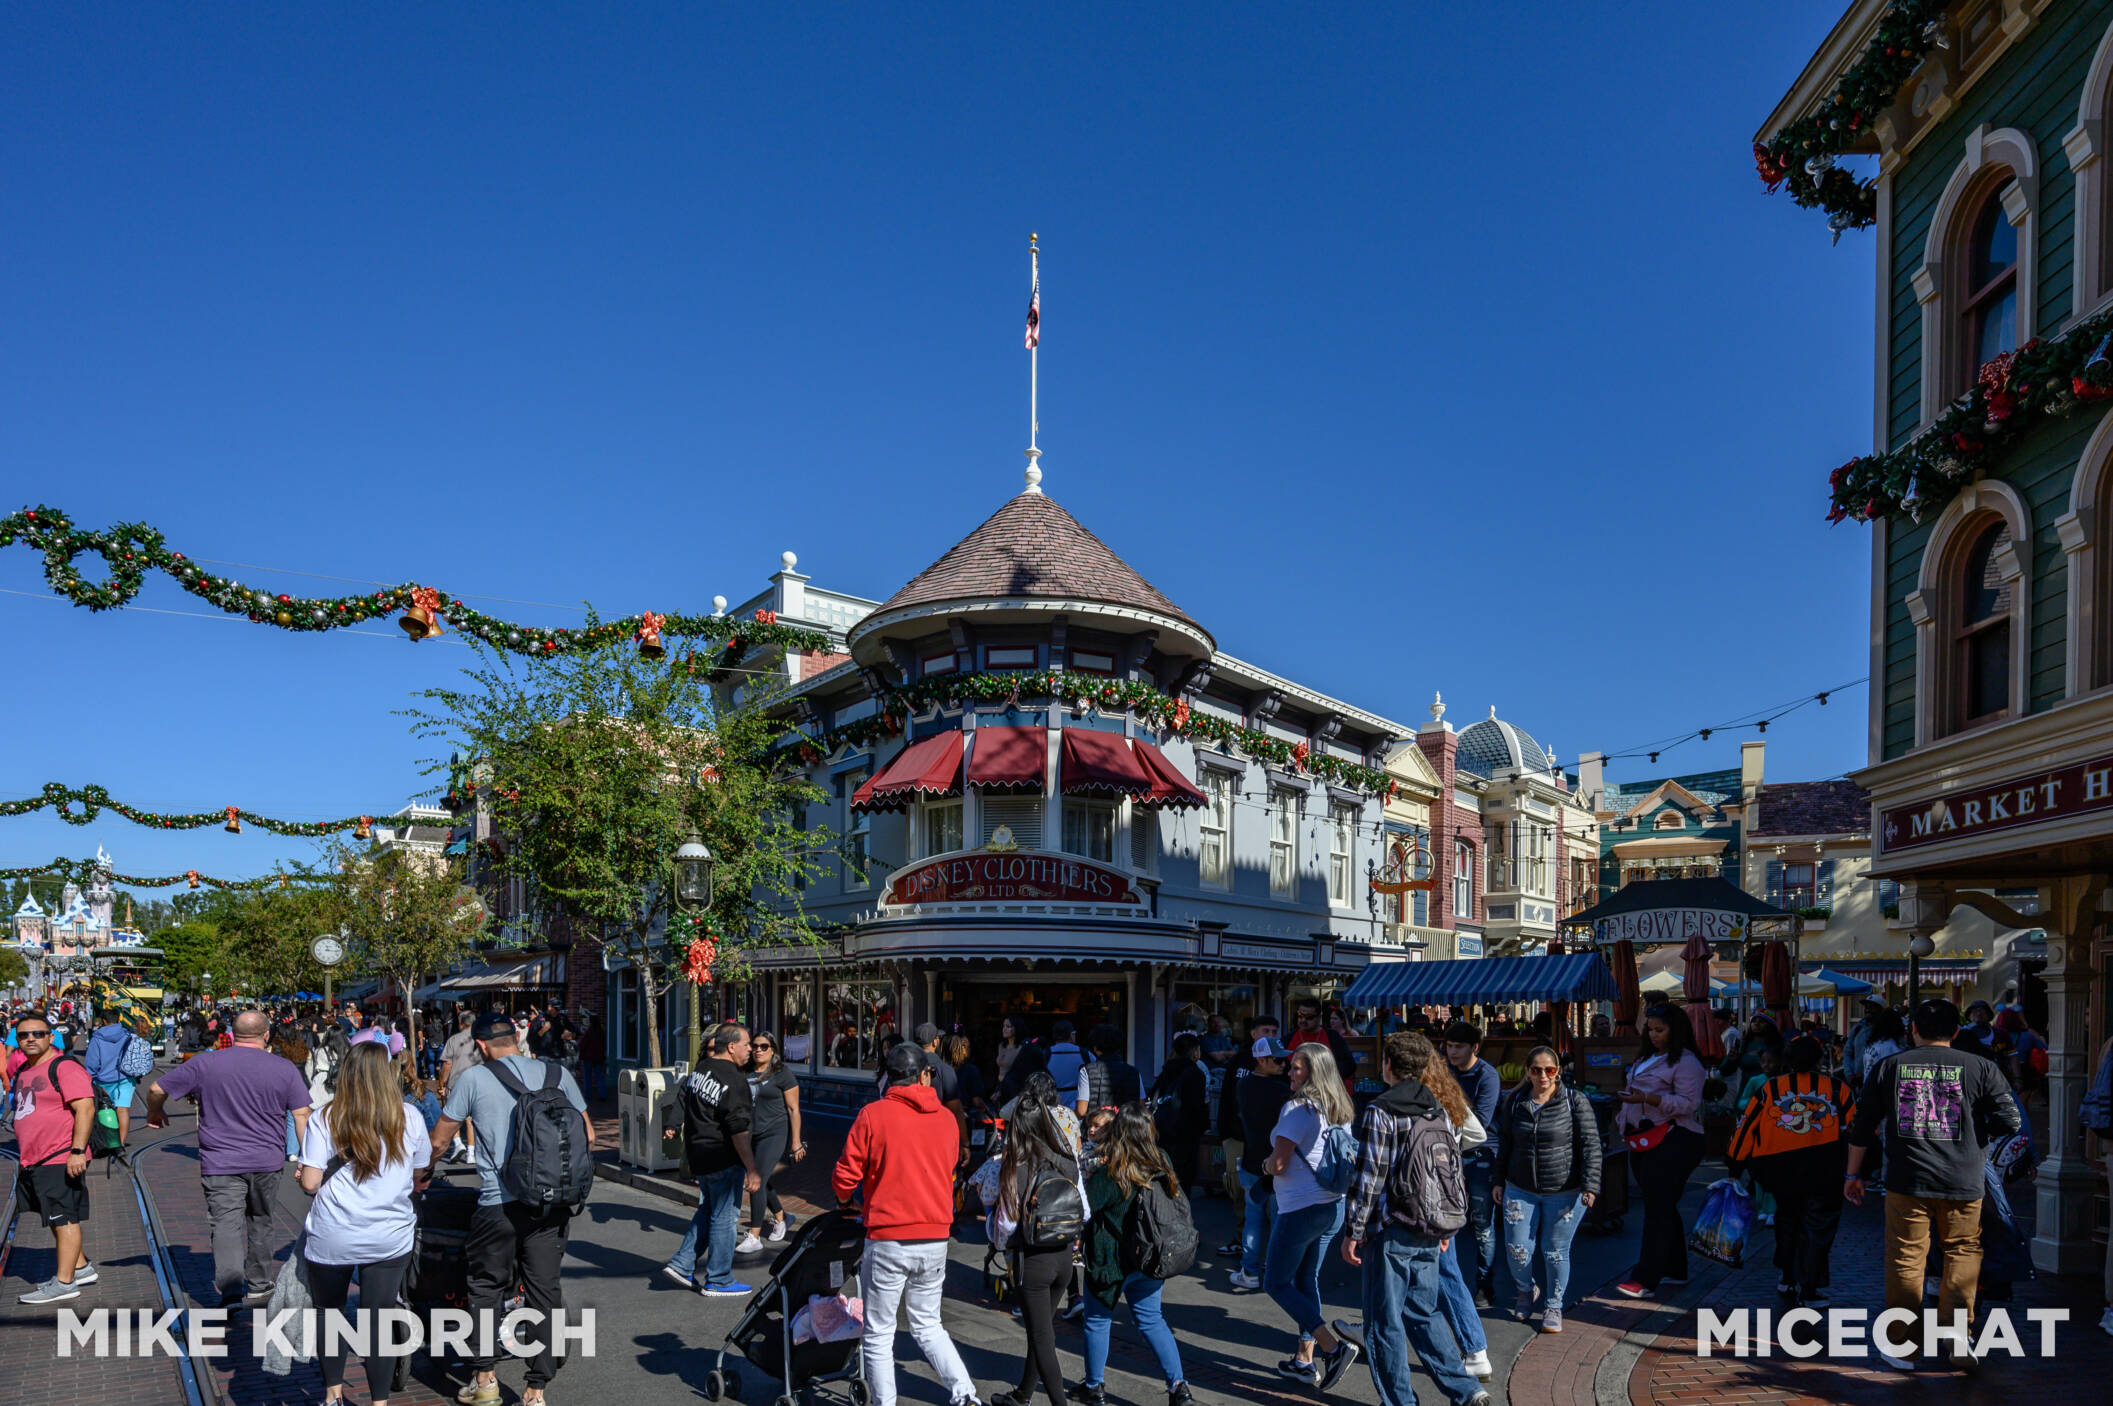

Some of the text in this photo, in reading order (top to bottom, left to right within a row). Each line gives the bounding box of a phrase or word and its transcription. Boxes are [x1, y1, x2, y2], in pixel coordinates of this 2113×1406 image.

[1910, 779, 2062, 838] MARKET
[905, 857, 1112, 898] DISNEY CLOTHIERS
[1606, 910, 1735, 940] FLOWERS
